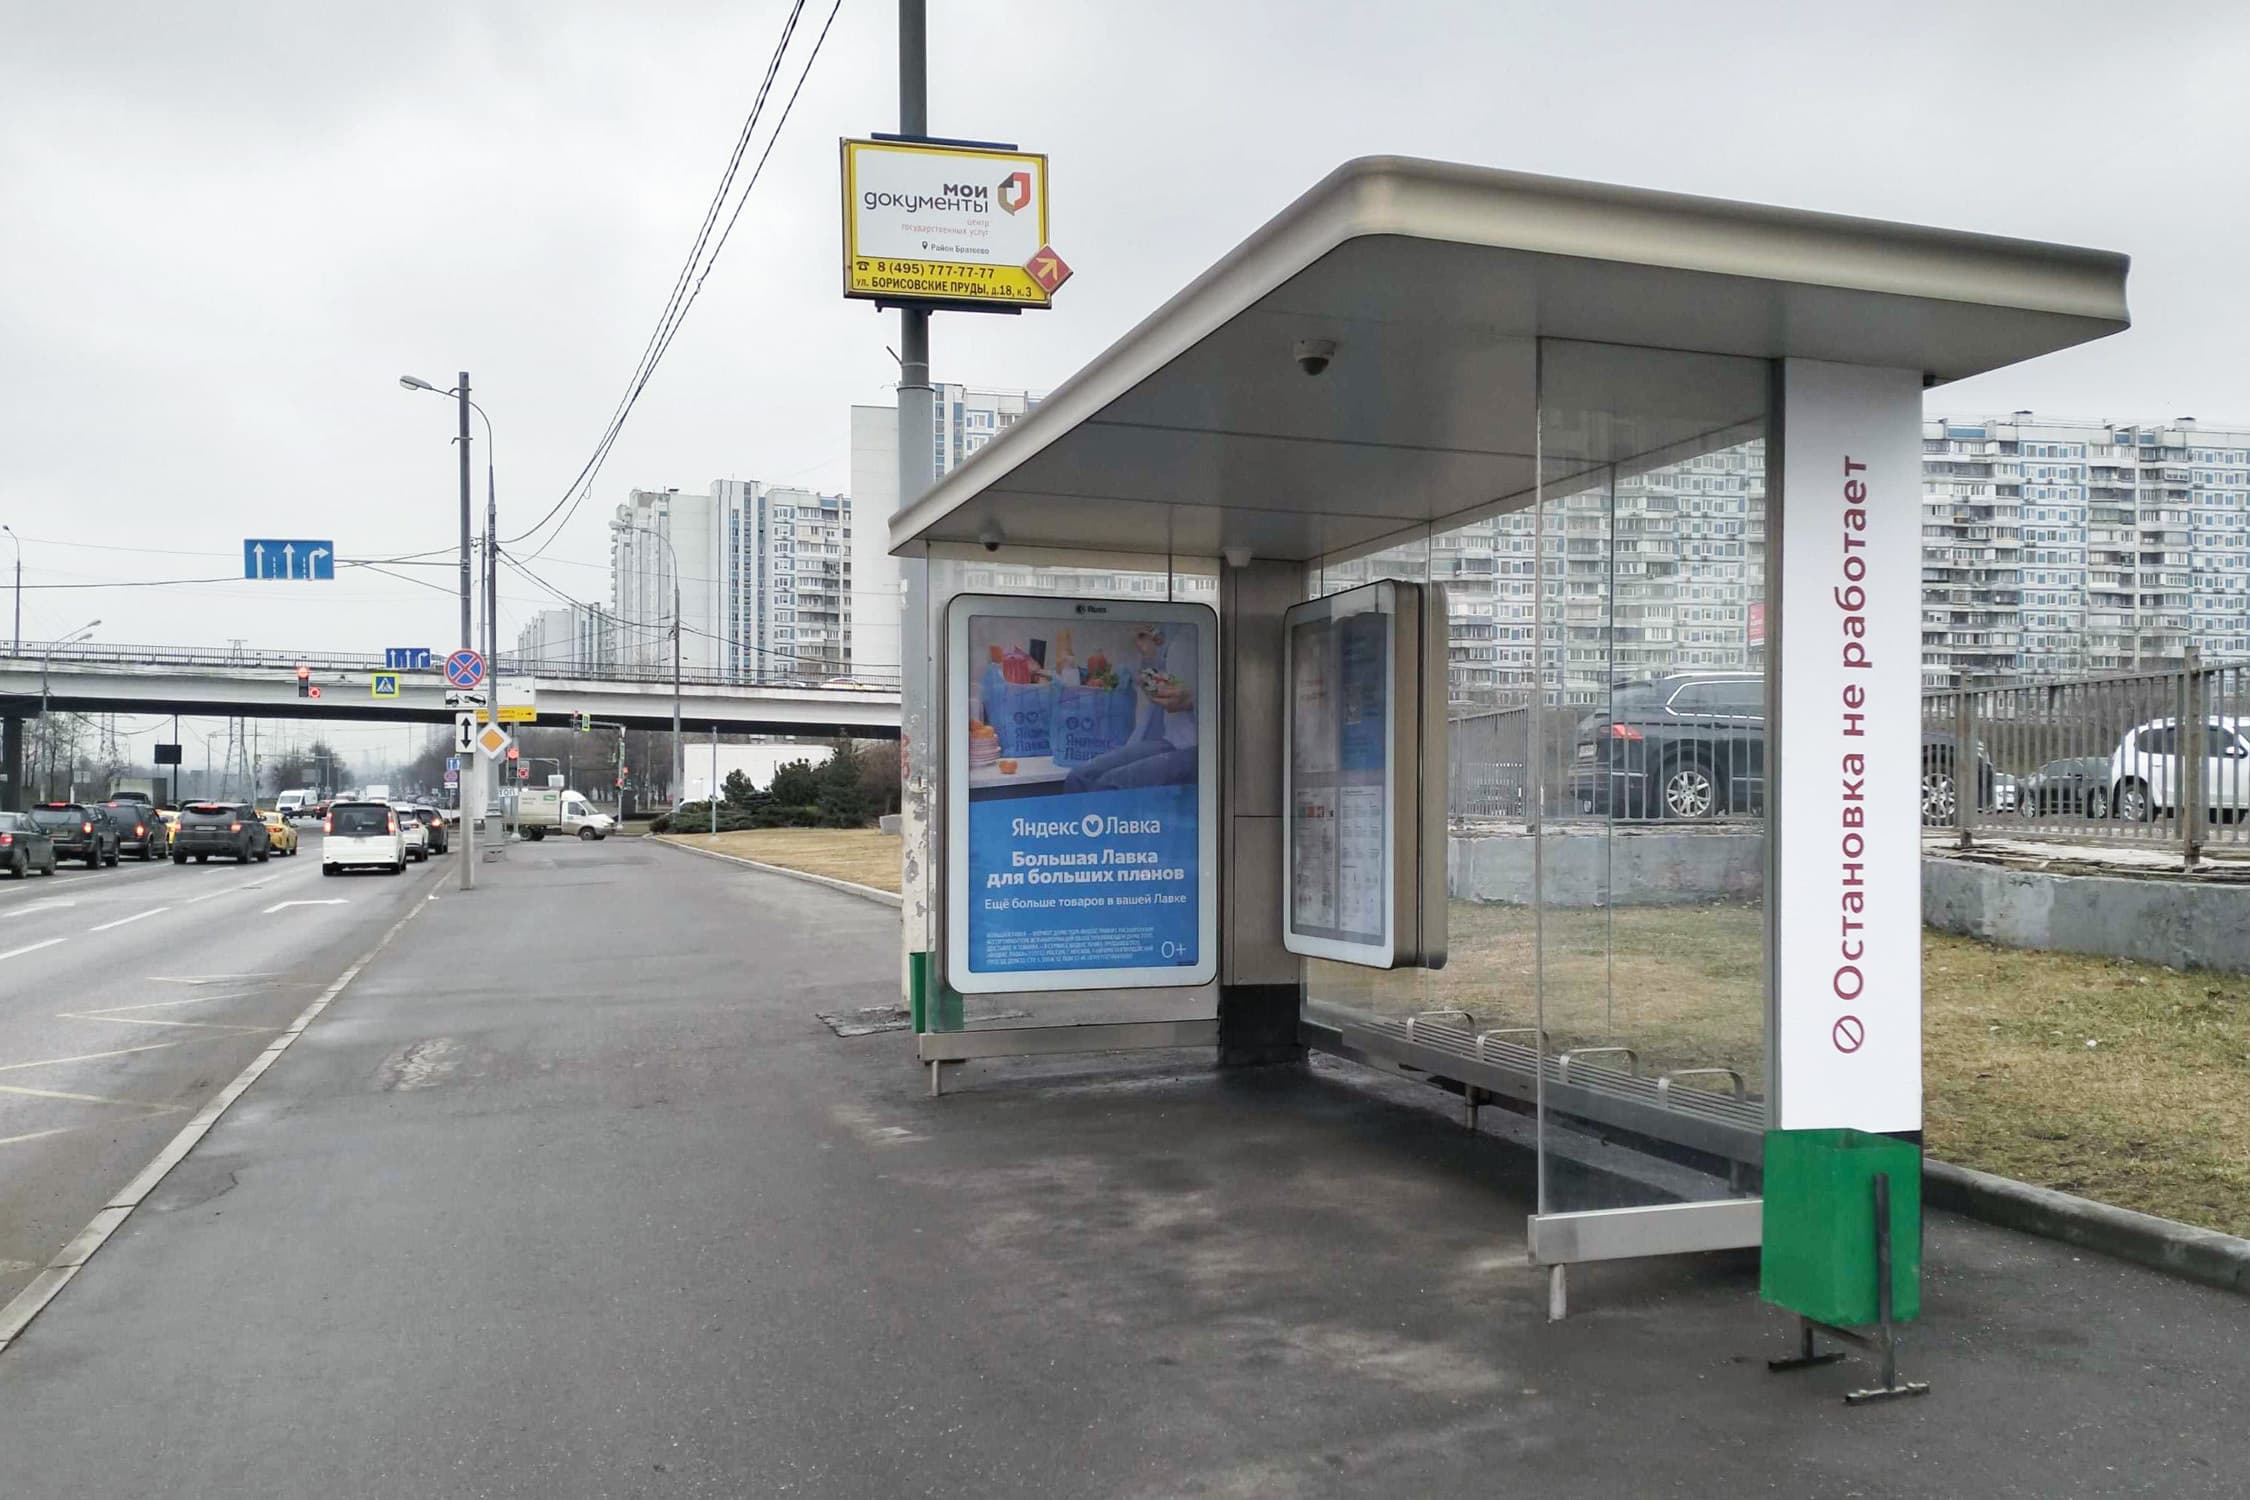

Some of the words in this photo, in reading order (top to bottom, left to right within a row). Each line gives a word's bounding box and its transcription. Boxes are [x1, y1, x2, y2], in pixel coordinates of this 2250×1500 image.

[943, 184, 987, 199] мои
[864, 191, 988, 213] документы
[930, 243, 954, 252] Район
[877, 261, 886, 272] 8
[889, 262, 925, 276] (495)
[928, 264, 995, 279] 777-77-77
[855, 278, 869, 287] ул.
[871, 276, 948, 292] БОРИСОВСКИЕ
[950, 281, 990, 296] ПРУДЫ,
[1834, 454, 1873, 668] работает
[1842, 683, 1866, 737] не
[1012, 818, 1079, 838] Яндекс
[1105, 816, 1161, 834] Лавка
[1012, 851, 1098, 868] Большая
[1101, 849, 1158, 866] Лавка
[986, 872, 1024, 889] для
[1028, 868, 1114, 885] больших
[1117, 867, 1185, 882] планов
[1833, 753, 1865, 1001] Остановка
[985, 898, 1009, 911] Ещё
[1012, 896, 1056, 909] больше
[1059, 896, 1105, 908] товаров
[1107, 896, 1114, 905] в
[1116, 893, 1152, 905] вашей
[1154, 892, 1187, 904] Лавке
[1160, 940, 1187, 959] 0+
